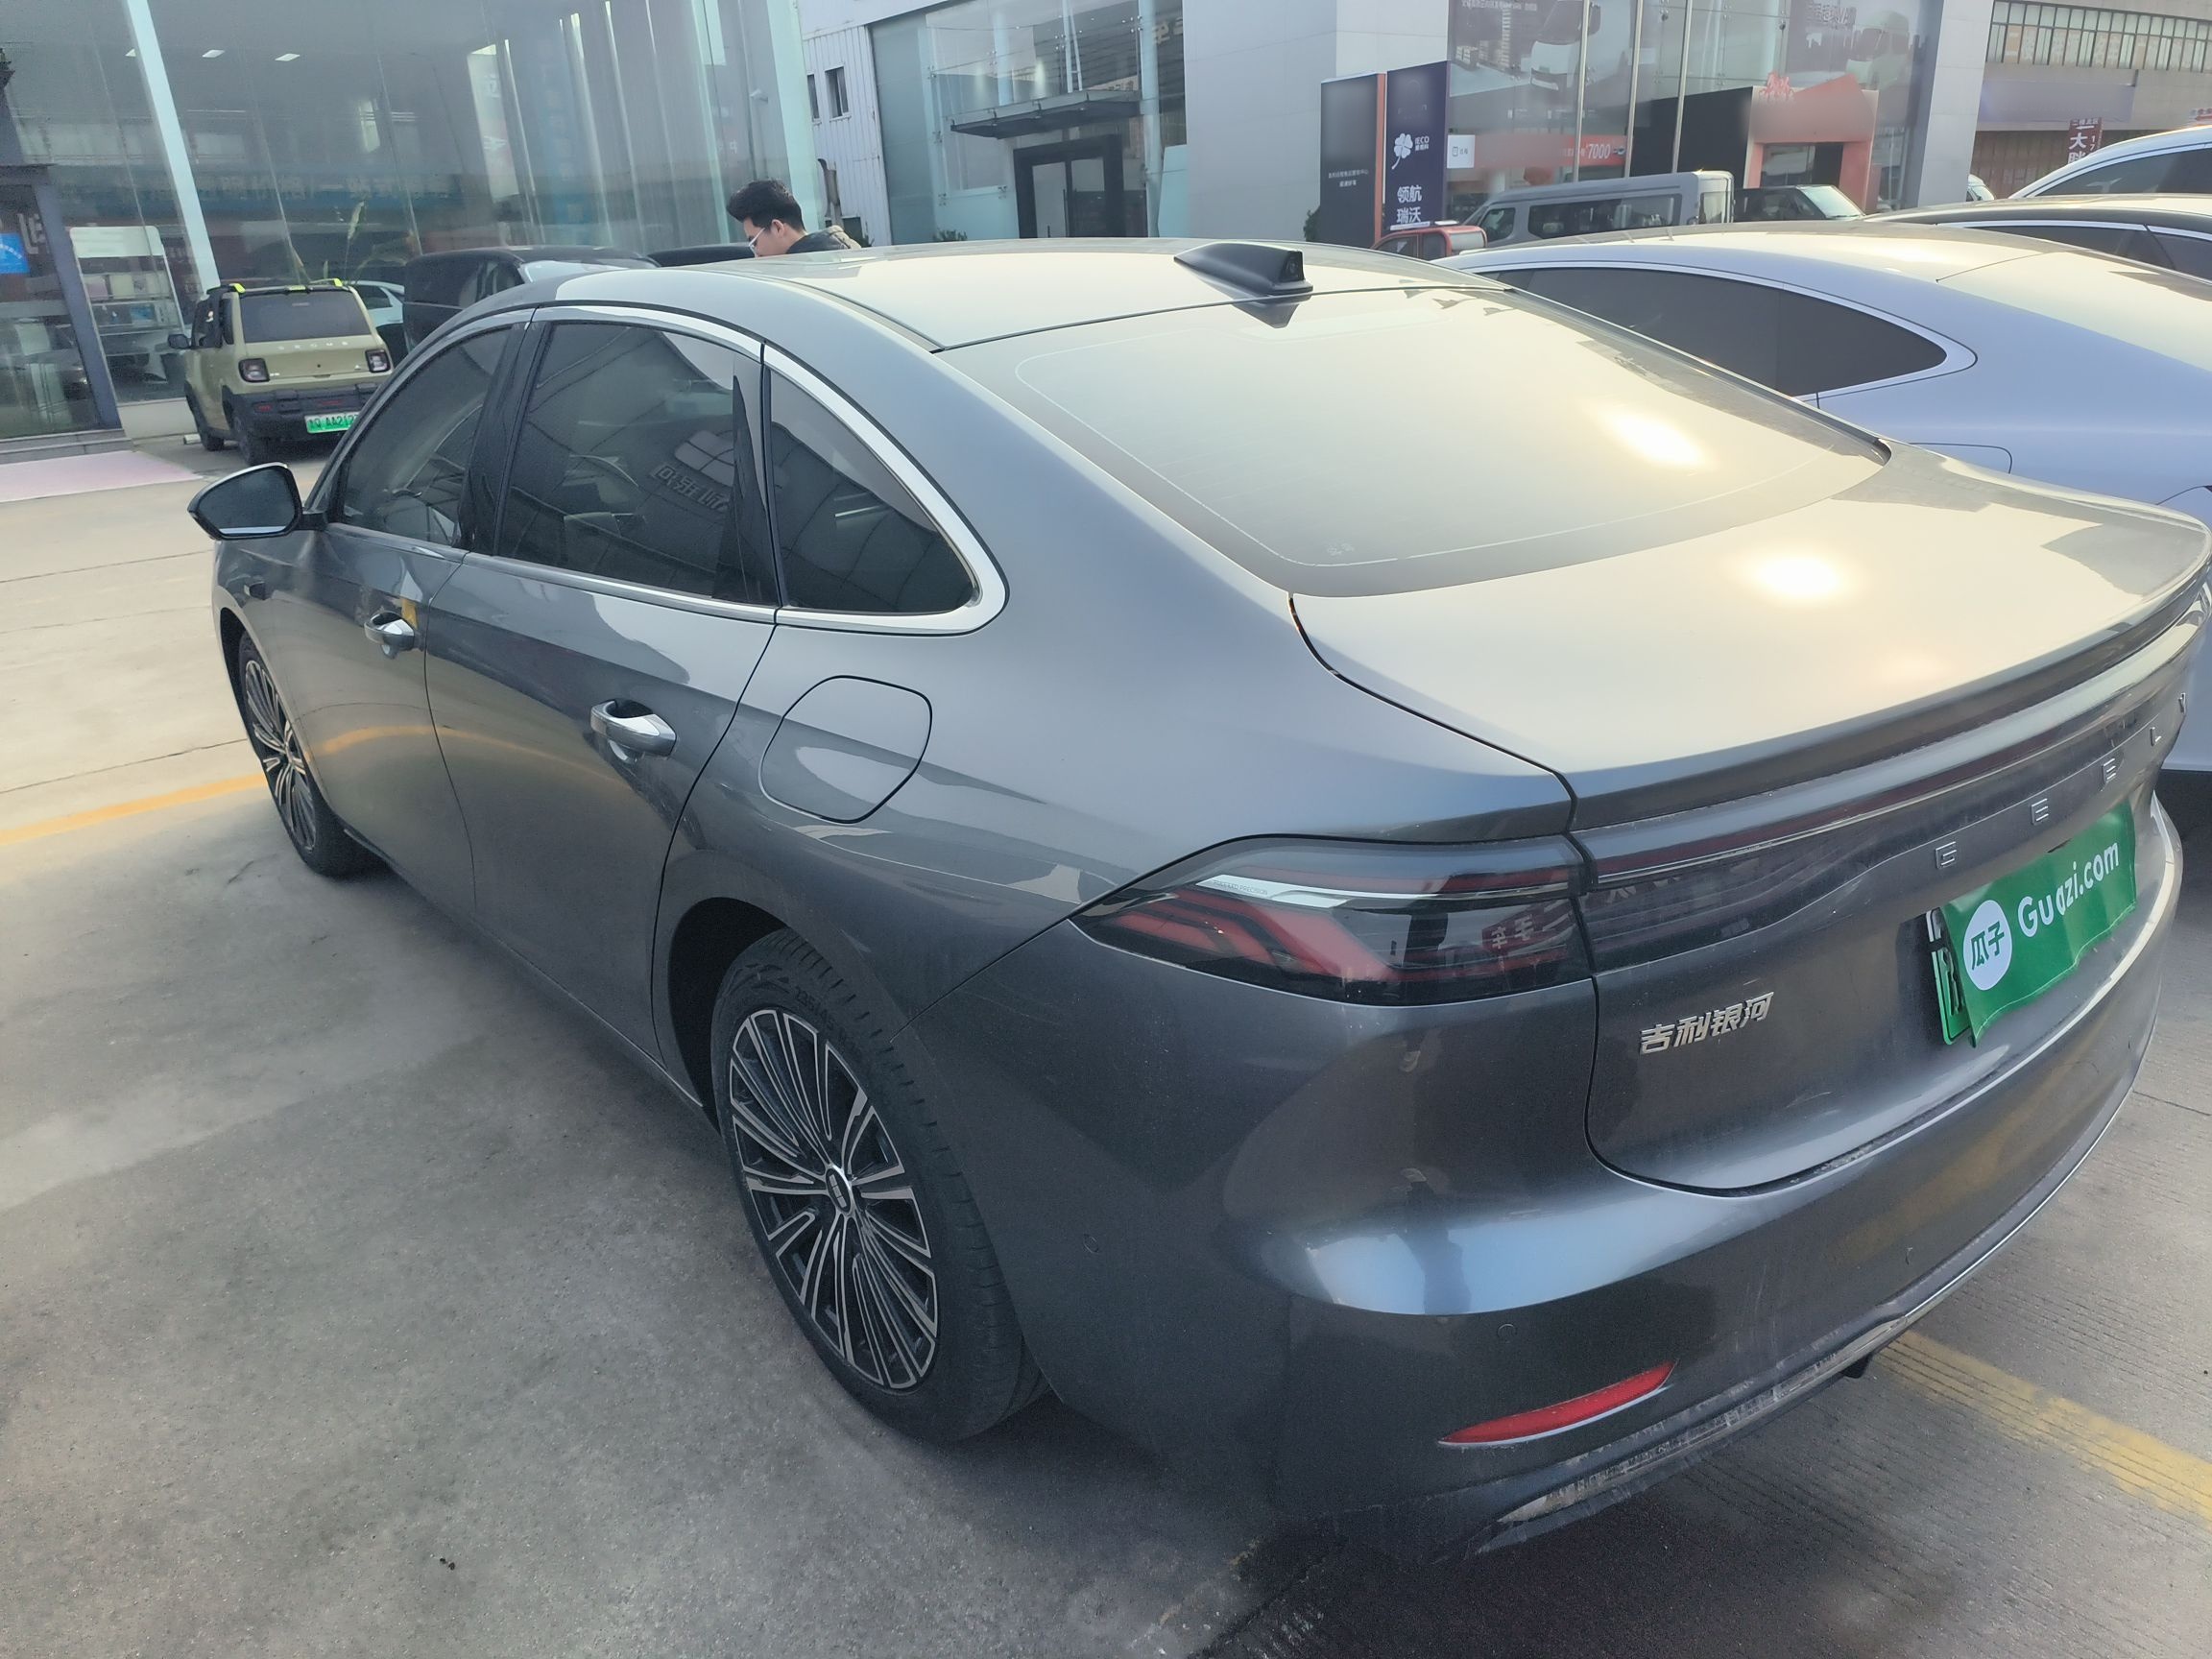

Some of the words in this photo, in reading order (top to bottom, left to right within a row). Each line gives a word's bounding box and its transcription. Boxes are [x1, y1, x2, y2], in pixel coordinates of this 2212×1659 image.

[1396, 206, 1422, 224] 瑞沃
[1397, 185, 1423, 204] 领航
[1970, 921, 2006, 971] 瓜子
[2017, 842, 2120, 938] Guazi.com
[1640, 992, 1774, 1055] 吉利银河
